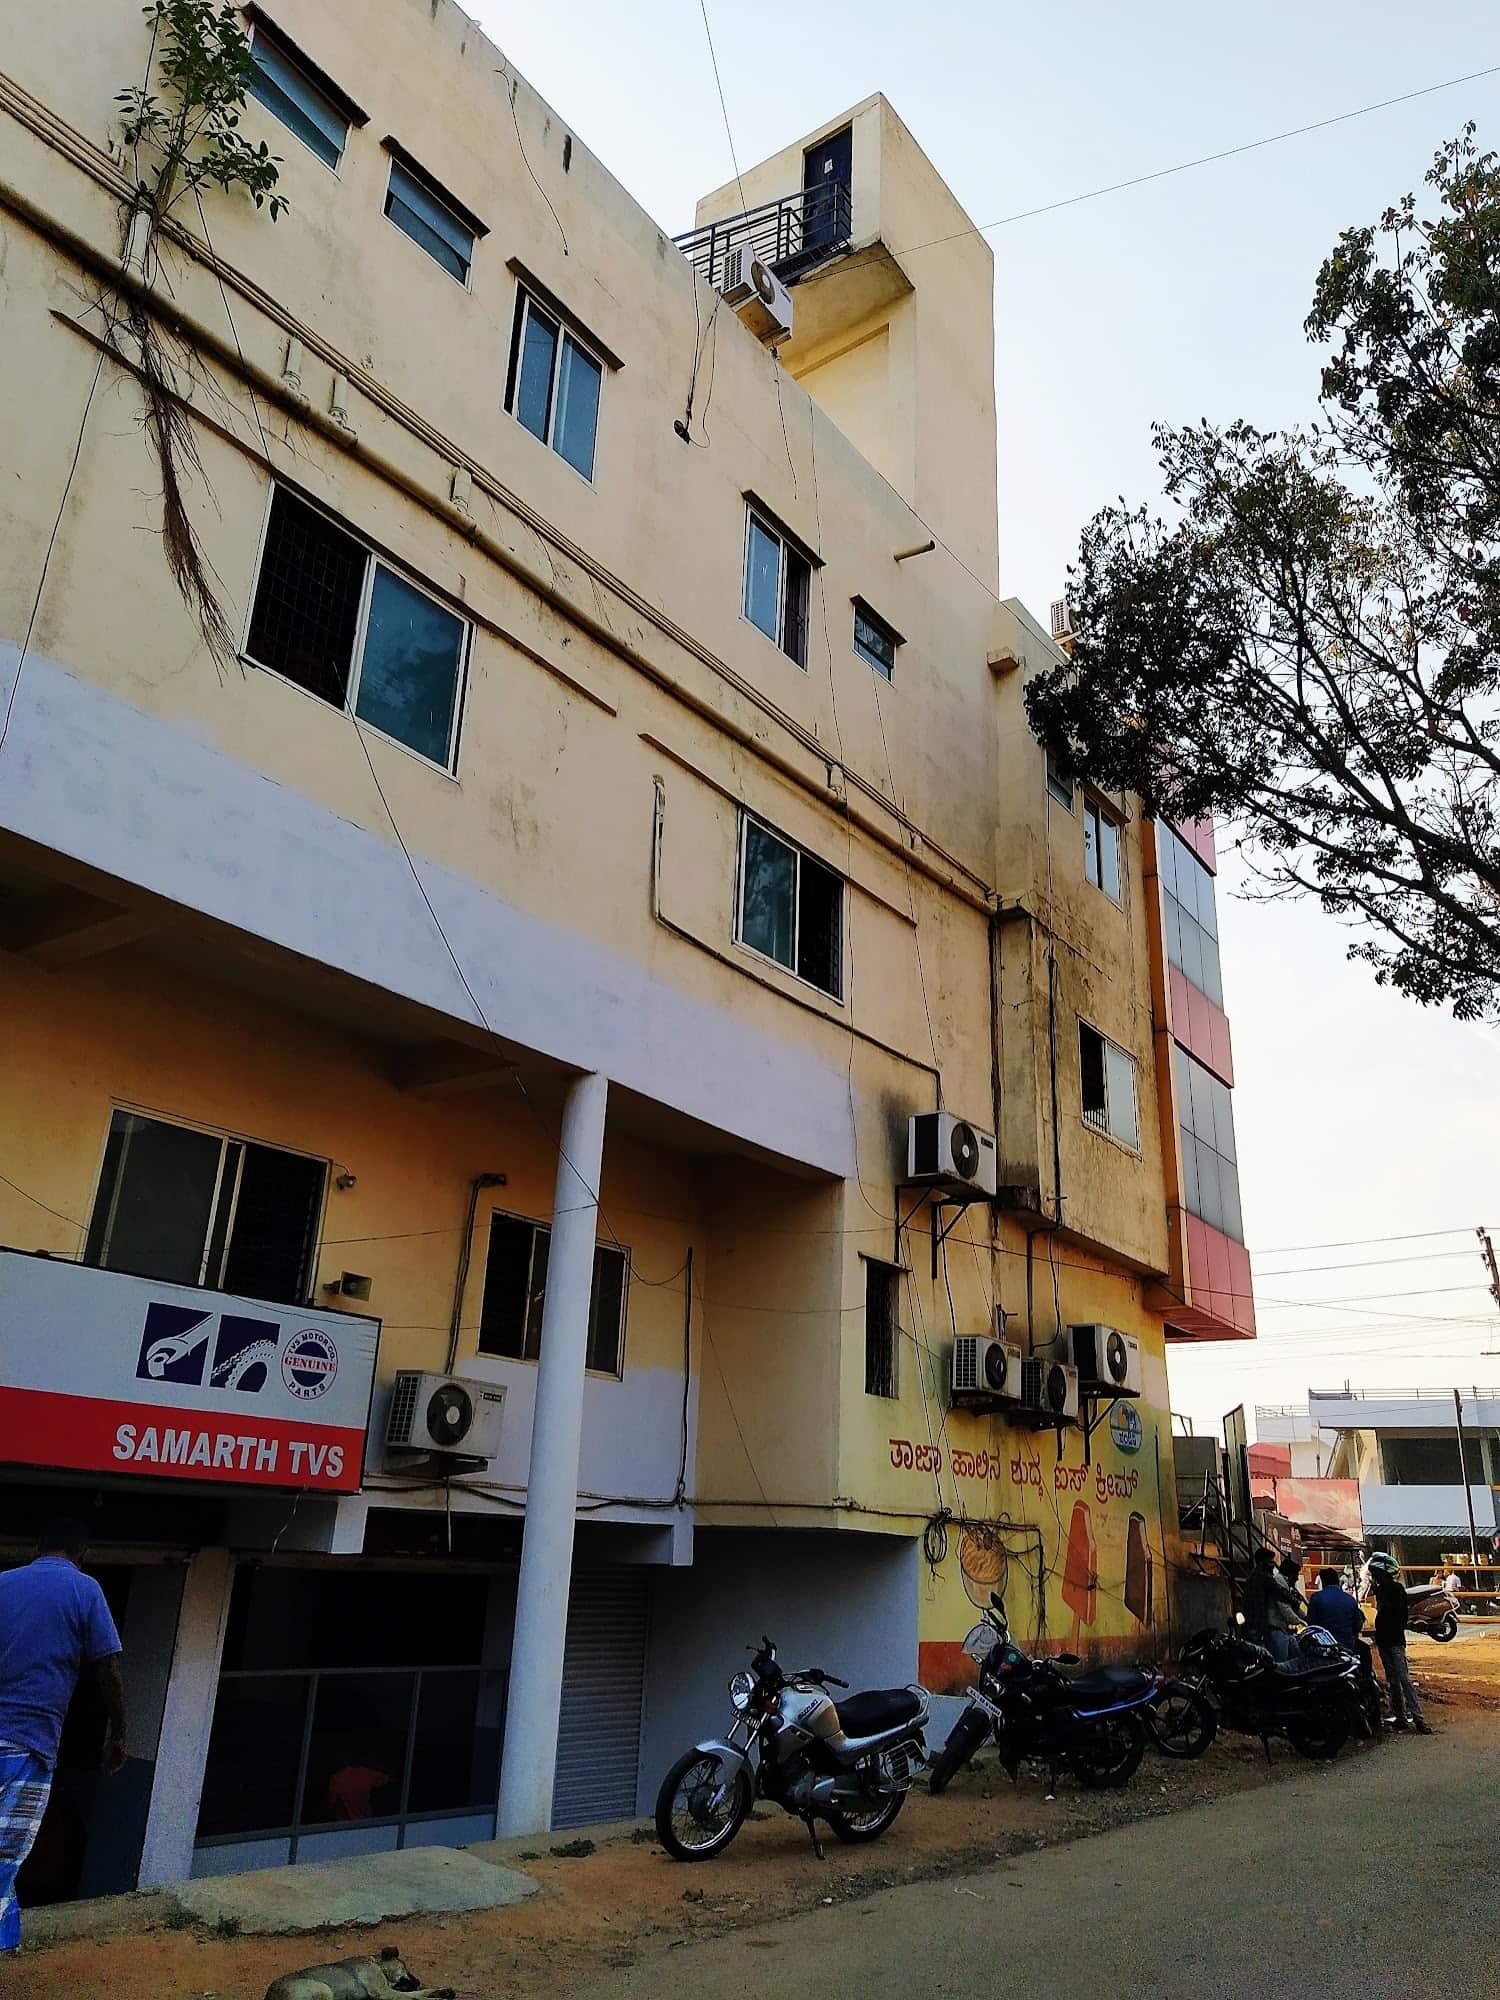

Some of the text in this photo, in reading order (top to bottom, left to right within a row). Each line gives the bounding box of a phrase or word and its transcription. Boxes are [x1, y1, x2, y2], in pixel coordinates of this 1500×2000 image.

[288, 1339, 301, 1354] TVS
[301, 1333, 329, 1346] MOTOR
[284, 1357, 336, 1372] GENUINE
[289, 1381, 326, 1397] PARTS
[112, 1424, 344, 1478] SAMARTH TVS
